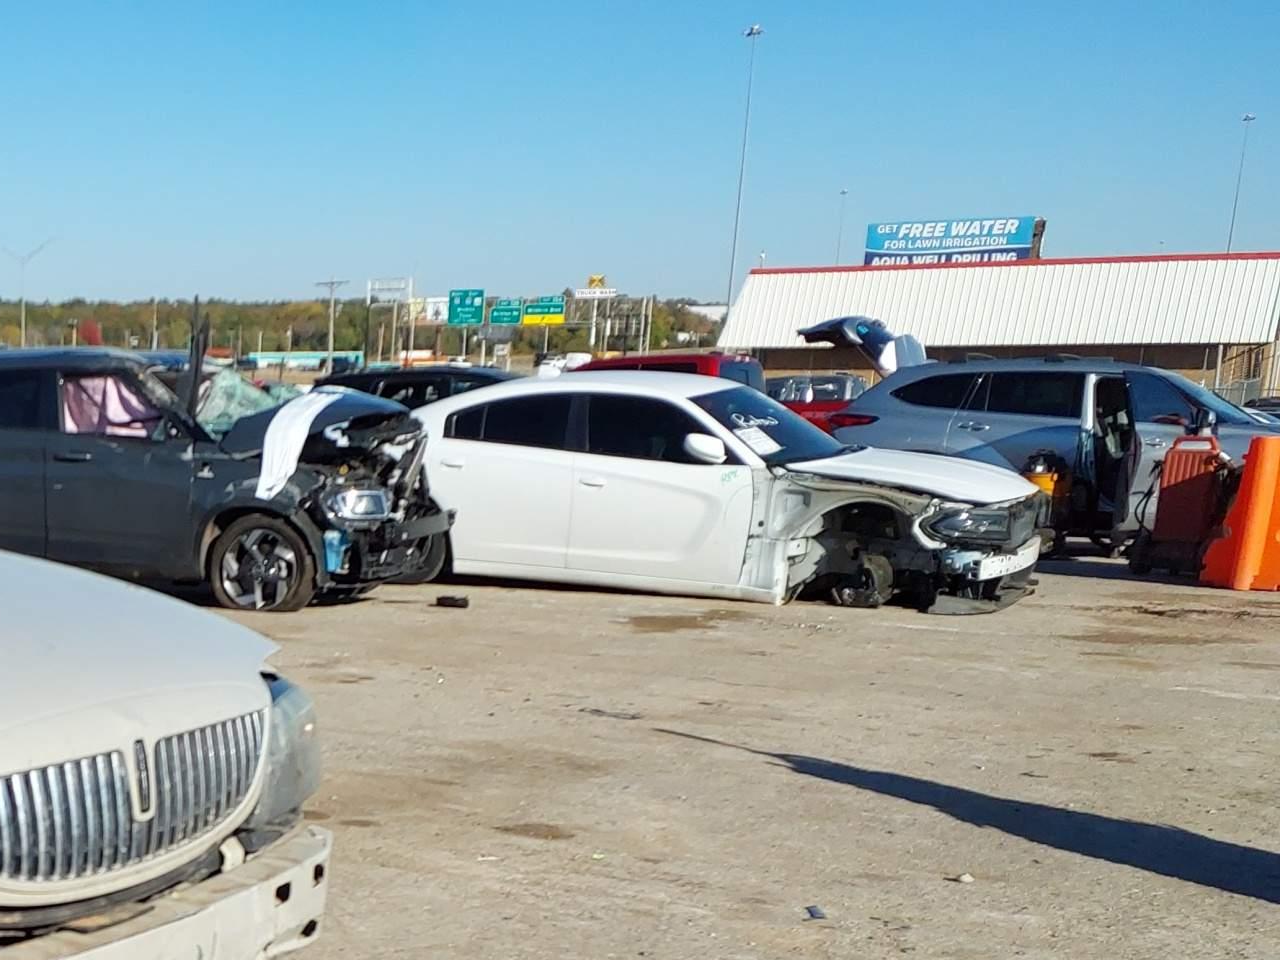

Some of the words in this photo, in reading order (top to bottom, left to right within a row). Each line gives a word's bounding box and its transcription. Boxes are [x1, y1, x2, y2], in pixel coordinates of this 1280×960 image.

[877, 224, 899, 234] GET
[898, 221, 946, 239] FREE
[951, 218, 1020, 236] WATER
[883, 239, 907, 250] FOR
[908, 238, 940, 249] LAWN
[942, 236, 1008, 248] IRRIGATION
